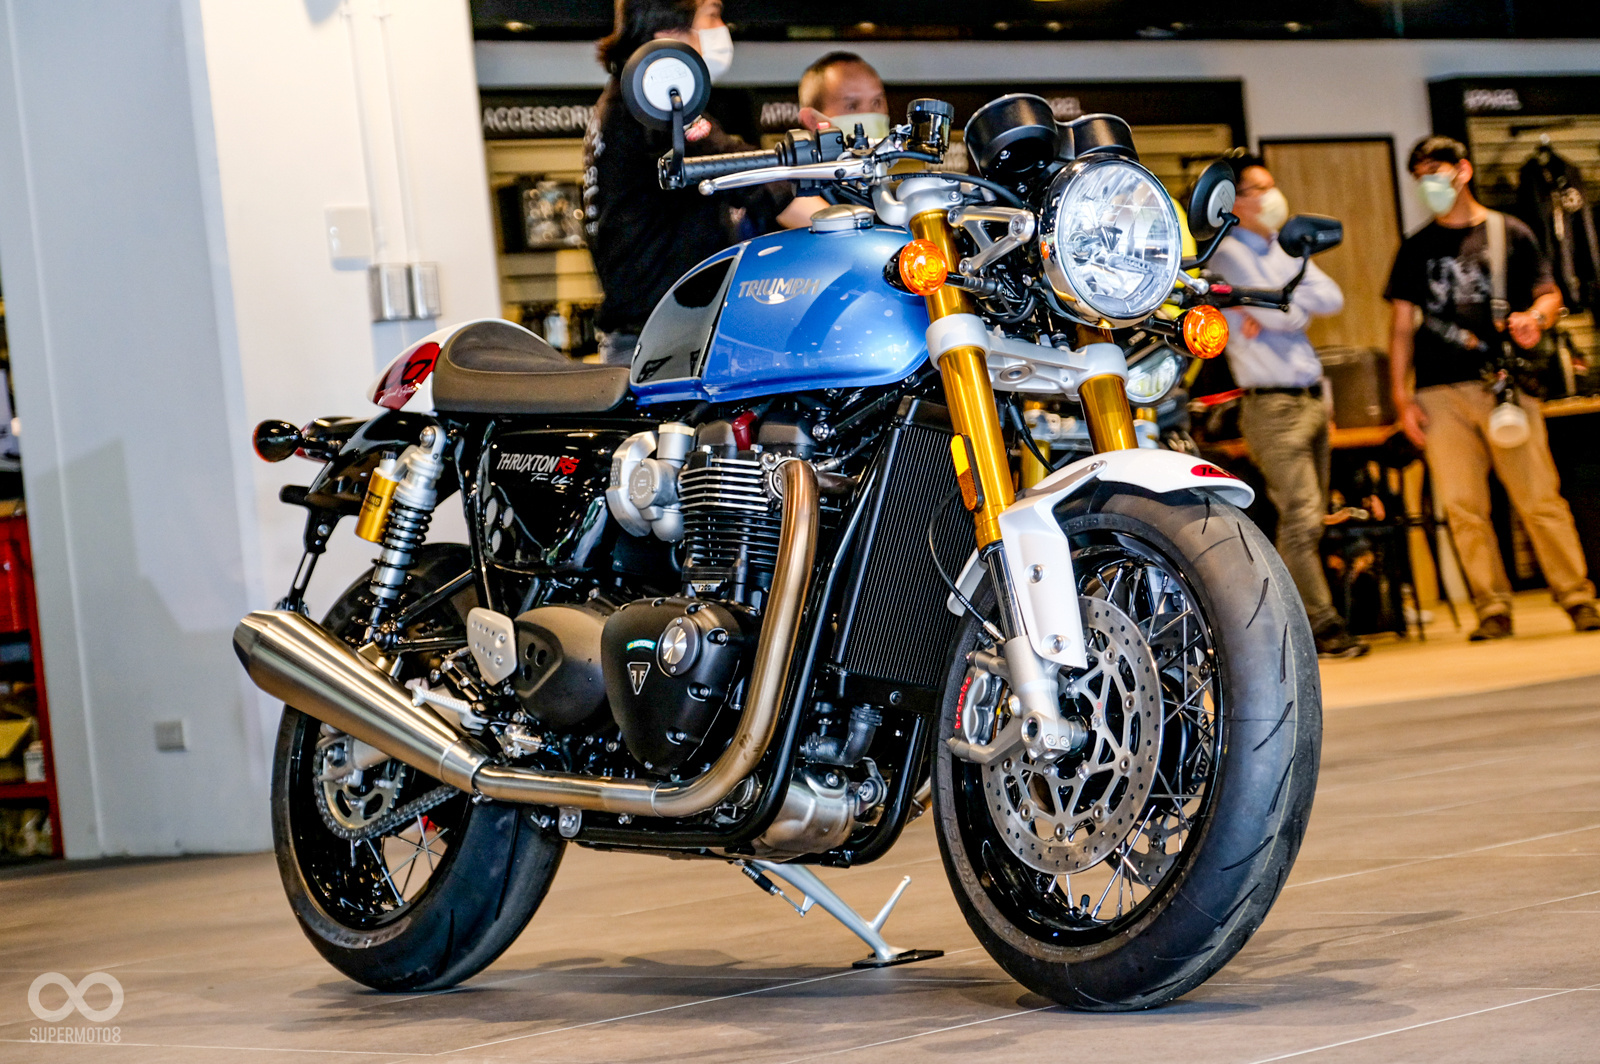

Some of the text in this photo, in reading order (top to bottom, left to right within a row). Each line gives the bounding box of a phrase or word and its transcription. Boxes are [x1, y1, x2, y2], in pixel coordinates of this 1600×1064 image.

[482, 105, 594, 131] ACCESSORI
[738, 277, 821, 303] TRIUMPH
[496, 453, 580, 475] THRUXTON RS
[954, 676, 972, 730] brembo
